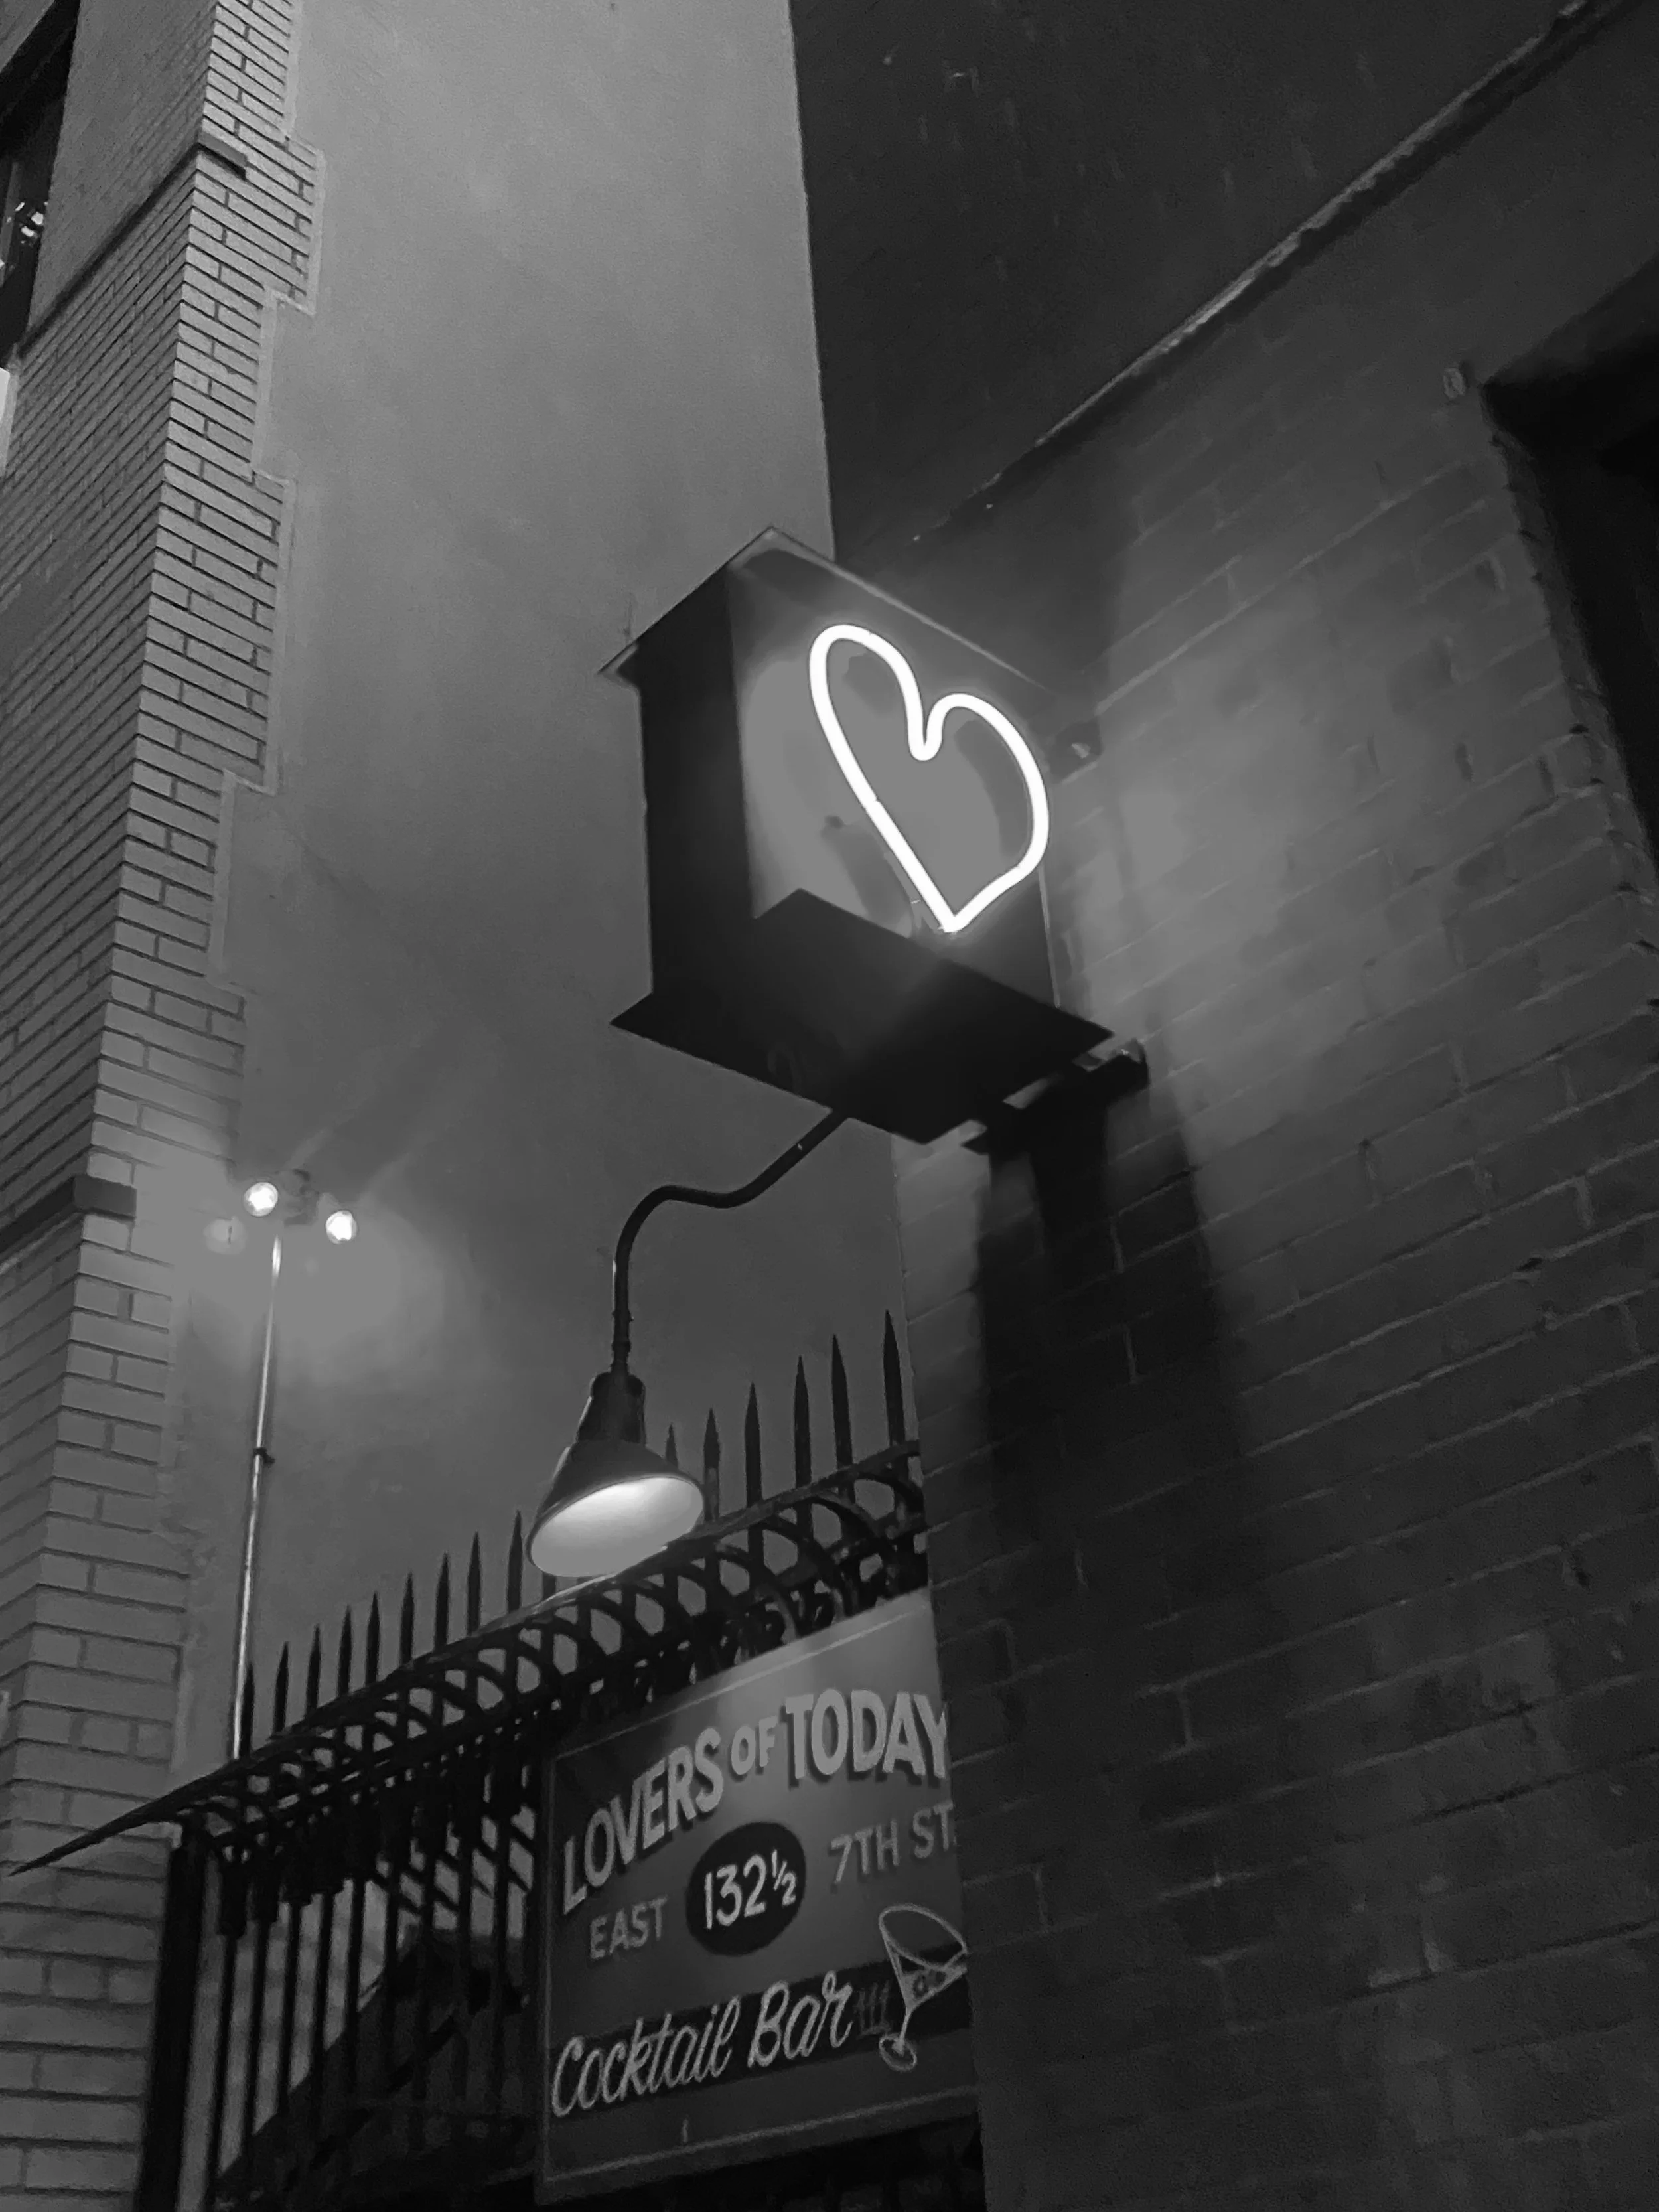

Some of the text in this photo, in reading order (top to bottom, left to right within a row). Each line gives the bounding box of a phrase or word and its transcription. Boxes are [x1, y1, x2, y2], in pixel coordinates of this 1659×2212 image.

[563, 1688, 948, 1915] LOVERS OF TODAY
[831, 1819, 899, 1884] 7TH
[590, 1895, 668, 1959] EAST
[551, 1970, 853, 2118] Cocktail Bar
